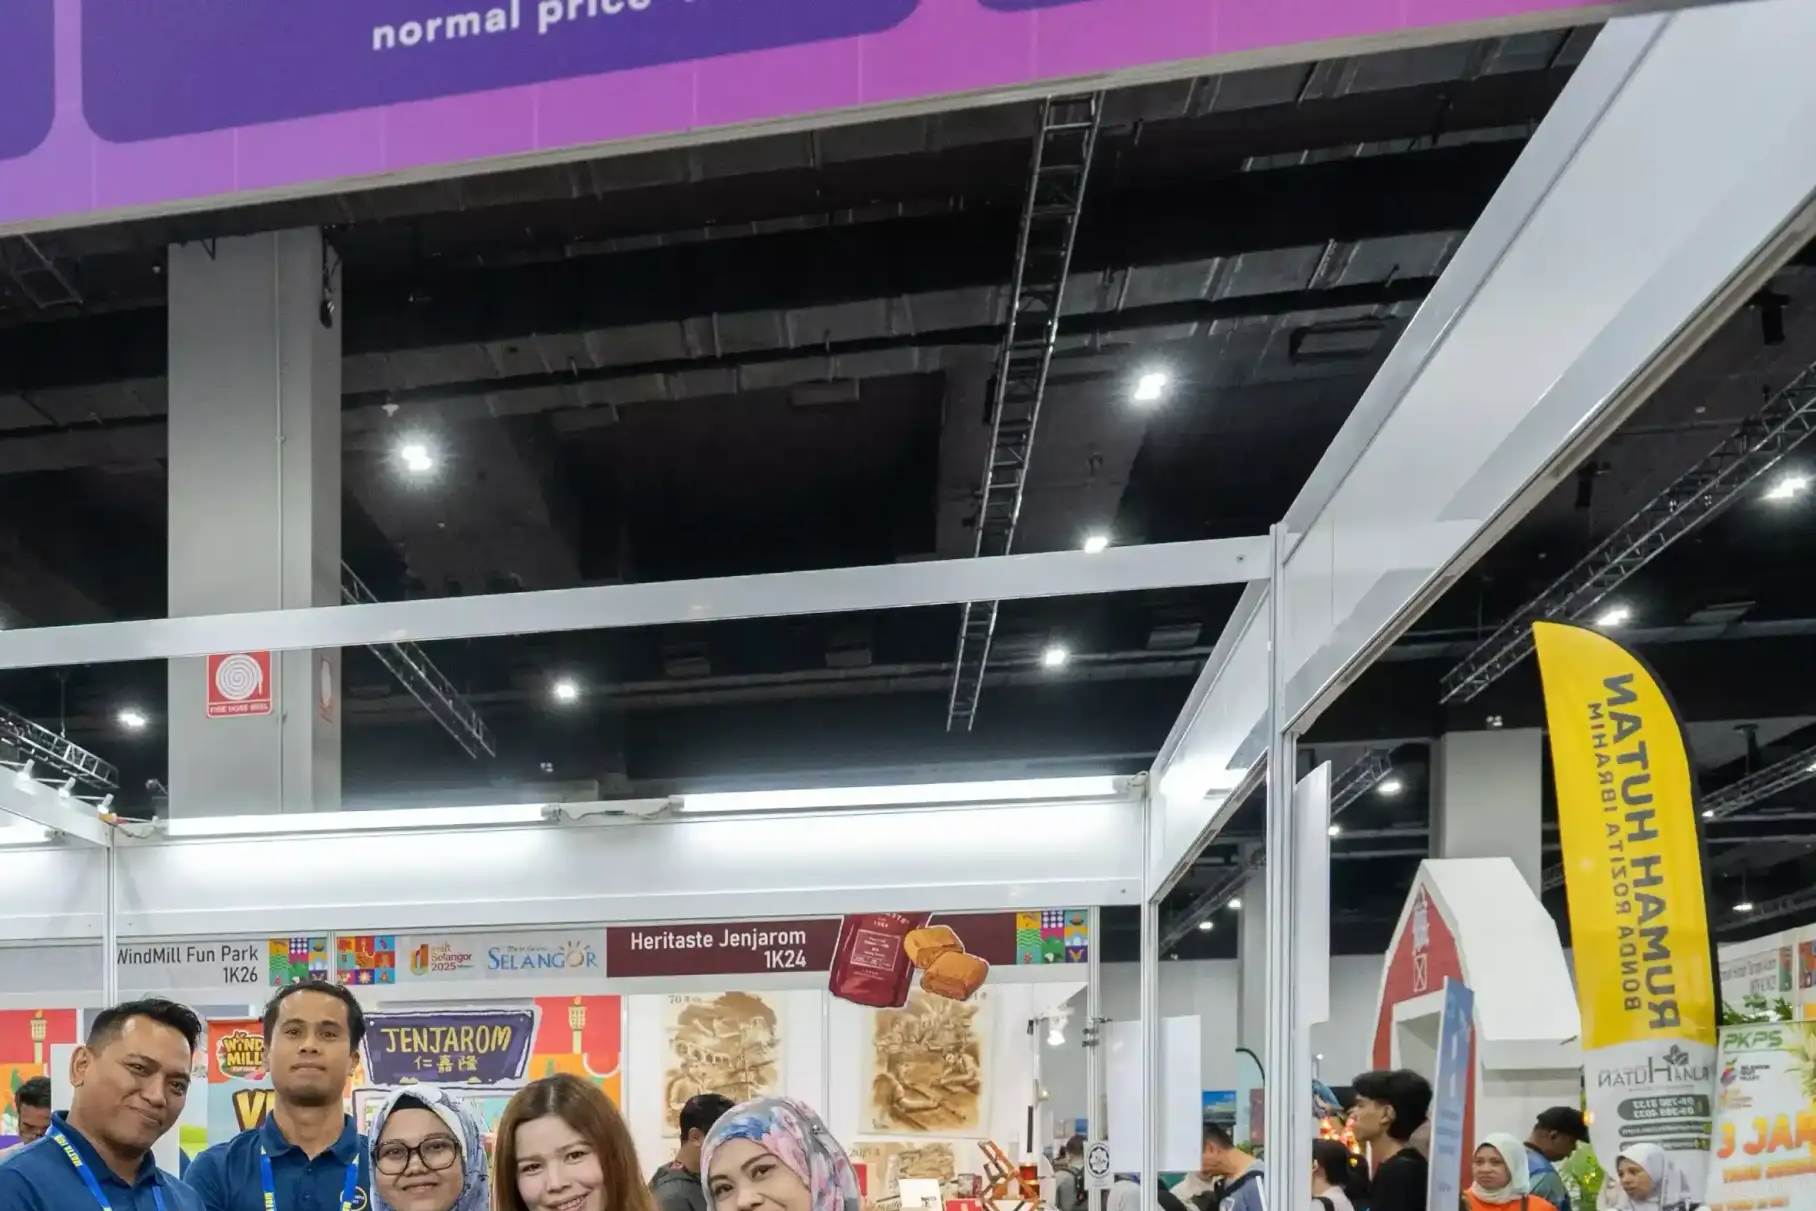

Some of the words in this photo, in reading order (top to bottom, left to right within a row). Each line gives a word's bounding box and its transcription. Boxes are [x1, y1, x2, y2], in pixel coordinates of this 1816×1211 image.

[372, 0, 520, 51] normal
[630, 931, 713, 951] Heritaste
[719, 927, 807, 949] Jenjarom
[186, 945, 215, 963] Fun
[221, 944, 259, 962] Park
[431, 952, 472, 962] Selangor
[764, 949, 807, 969] 1K24
[222, 965, 259, 983] 1K26
[431, 962, 457, 972] 2025
[380, 1025, 511, 1053] JENJAROM
[1723, 1029, 1785, 1050] PKPS
